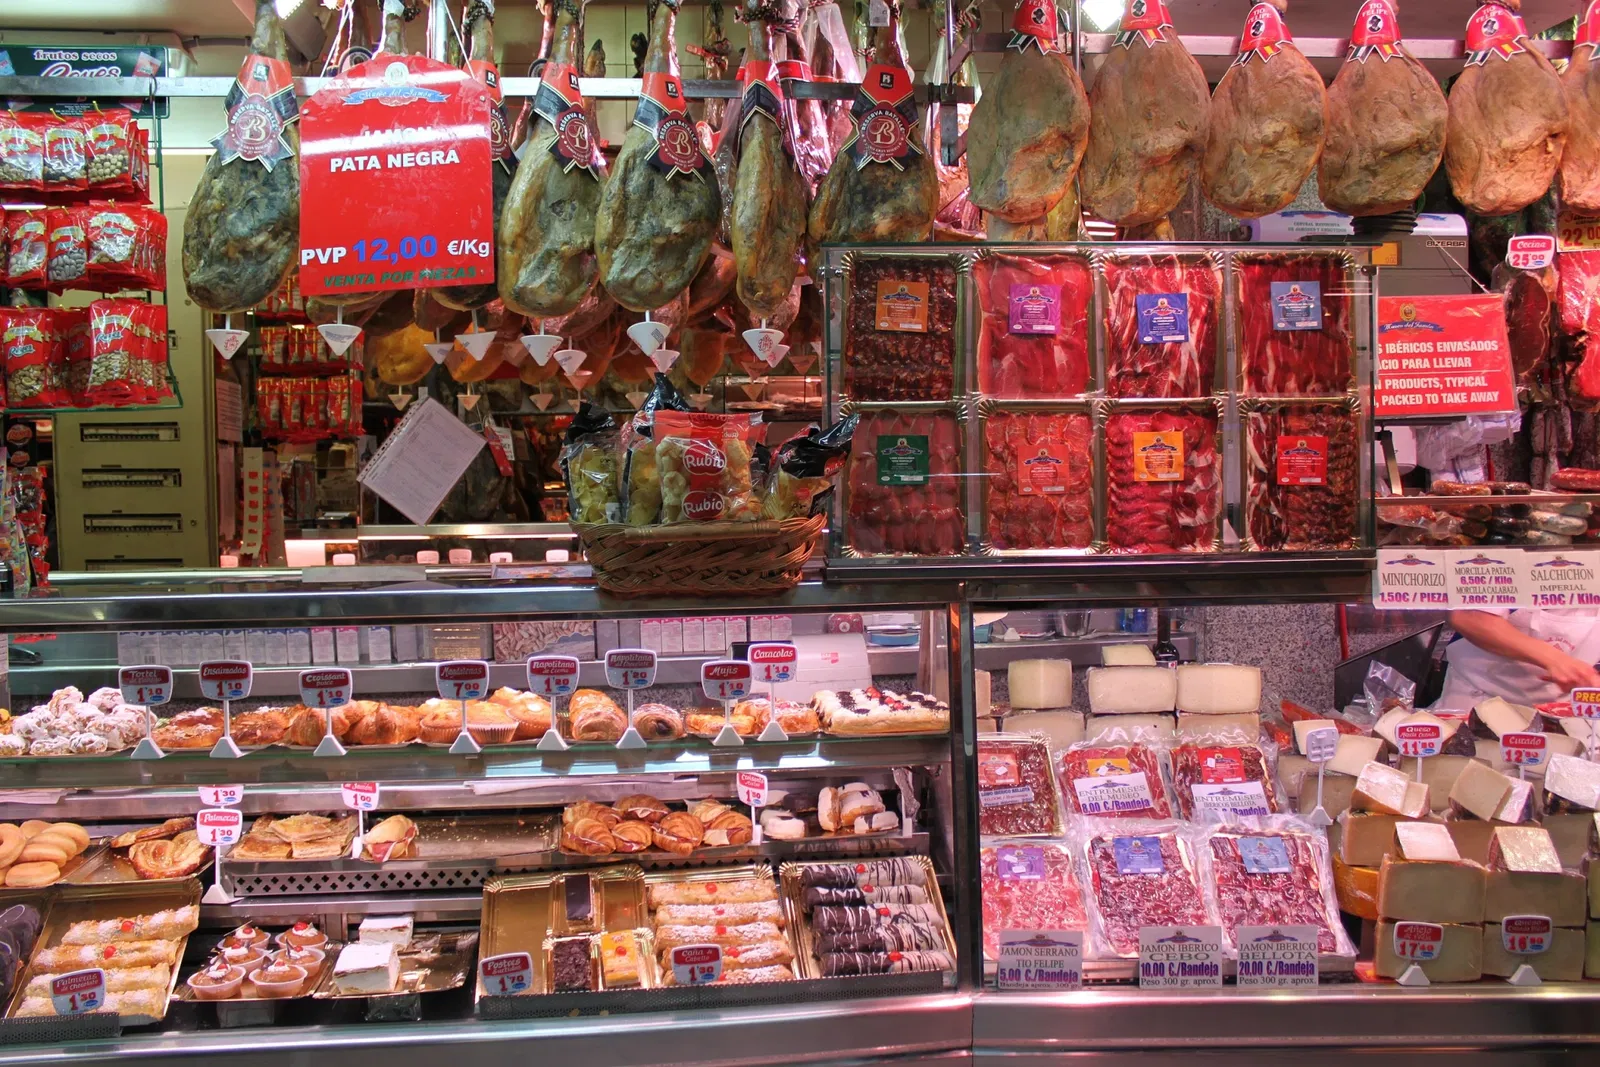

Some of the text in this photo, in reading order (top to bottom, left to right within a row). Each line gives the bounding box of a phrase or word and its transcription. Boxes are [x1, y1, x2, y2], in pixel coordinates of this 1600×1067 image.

[33, 49, 118, 61] frutos secos
[329, 149, 460, 173] PATA NEGRA
[301, 234, 490, 266] PVP 12,00 €/Kg
[1516, 240, 1547, 249] Cecina
[323, 265, 476, 289] VENTA POR PIEZAS
[1385, 340, 1434, 354] IBÉRICOS
[1436, 340, 1499, 353] ENVASADOS
[1401, 358, 1431, 369] PARA
[1433, 357, 1472, 369] LLEVAR
[1385, 377, 1443, 390] PRODUCTS,
[1444, 376, 1488, 387] TYPICAL
[1382, 395, 1422, 406] PACKED
[1424, 394, 1437, 404] TO
[1444, 392, 1468, 404] TAKE
[1469, 391, 1499, 402] AWAY
[683, 499, 723, 513] Rubio
[1454, 567, 1516, 575] MORCILLA PATATA
[1530, 568, 1595, 582] SALCHICHON
[1381, 572, 1446, 587] MINICHORIZO
[1494, 576, 1513, 585] Kilo
[1455, 586, 1518, 594] MORCILLA CALABAZA
[1539, 584, 1587, 592] IMPERIAL
[1420, 592, 1449, 604] PIEZA
[1496, 595, 1516, 604] Kilo
[753, 649, 794, 661] Caracolas
[532, 660, 575, 669] Napolitana
[203, 665, 247, 676] Ensaimadas
[709, 666, 739, 677] Mujis
[305, 672, 346, 683] Croissant
[1509, 736, 1542, 746] Curado
[213, 789, 236, 803] 1'30
[1079, 785, 1147, 797] ENTREMESES
[1107, 792, 1140, 801] MUSEO
[1195, 793, 1263, 803] ENTREMESES
[210, 828, 233, 842] 1'30
[1000, 947, 1079, 957] JAMON SERRANO
[1140, 943, 1219, 953] JAMON IBERICO
[1239, 942, 1317, 952] JAMON IBERICO
[1149, 952, 1210, 961] CEBO
[1239, 952, 1316, 960] BELLOTA
[1016, 959, 1065, 968] TIO FELIPE
[56, 973, 98, 988] Palmeras
[1140, 977, 1219, 987] Peso 300 gr. aprox.
[1239, 976, 1317, 986] Peso 300 gr. aprox.
